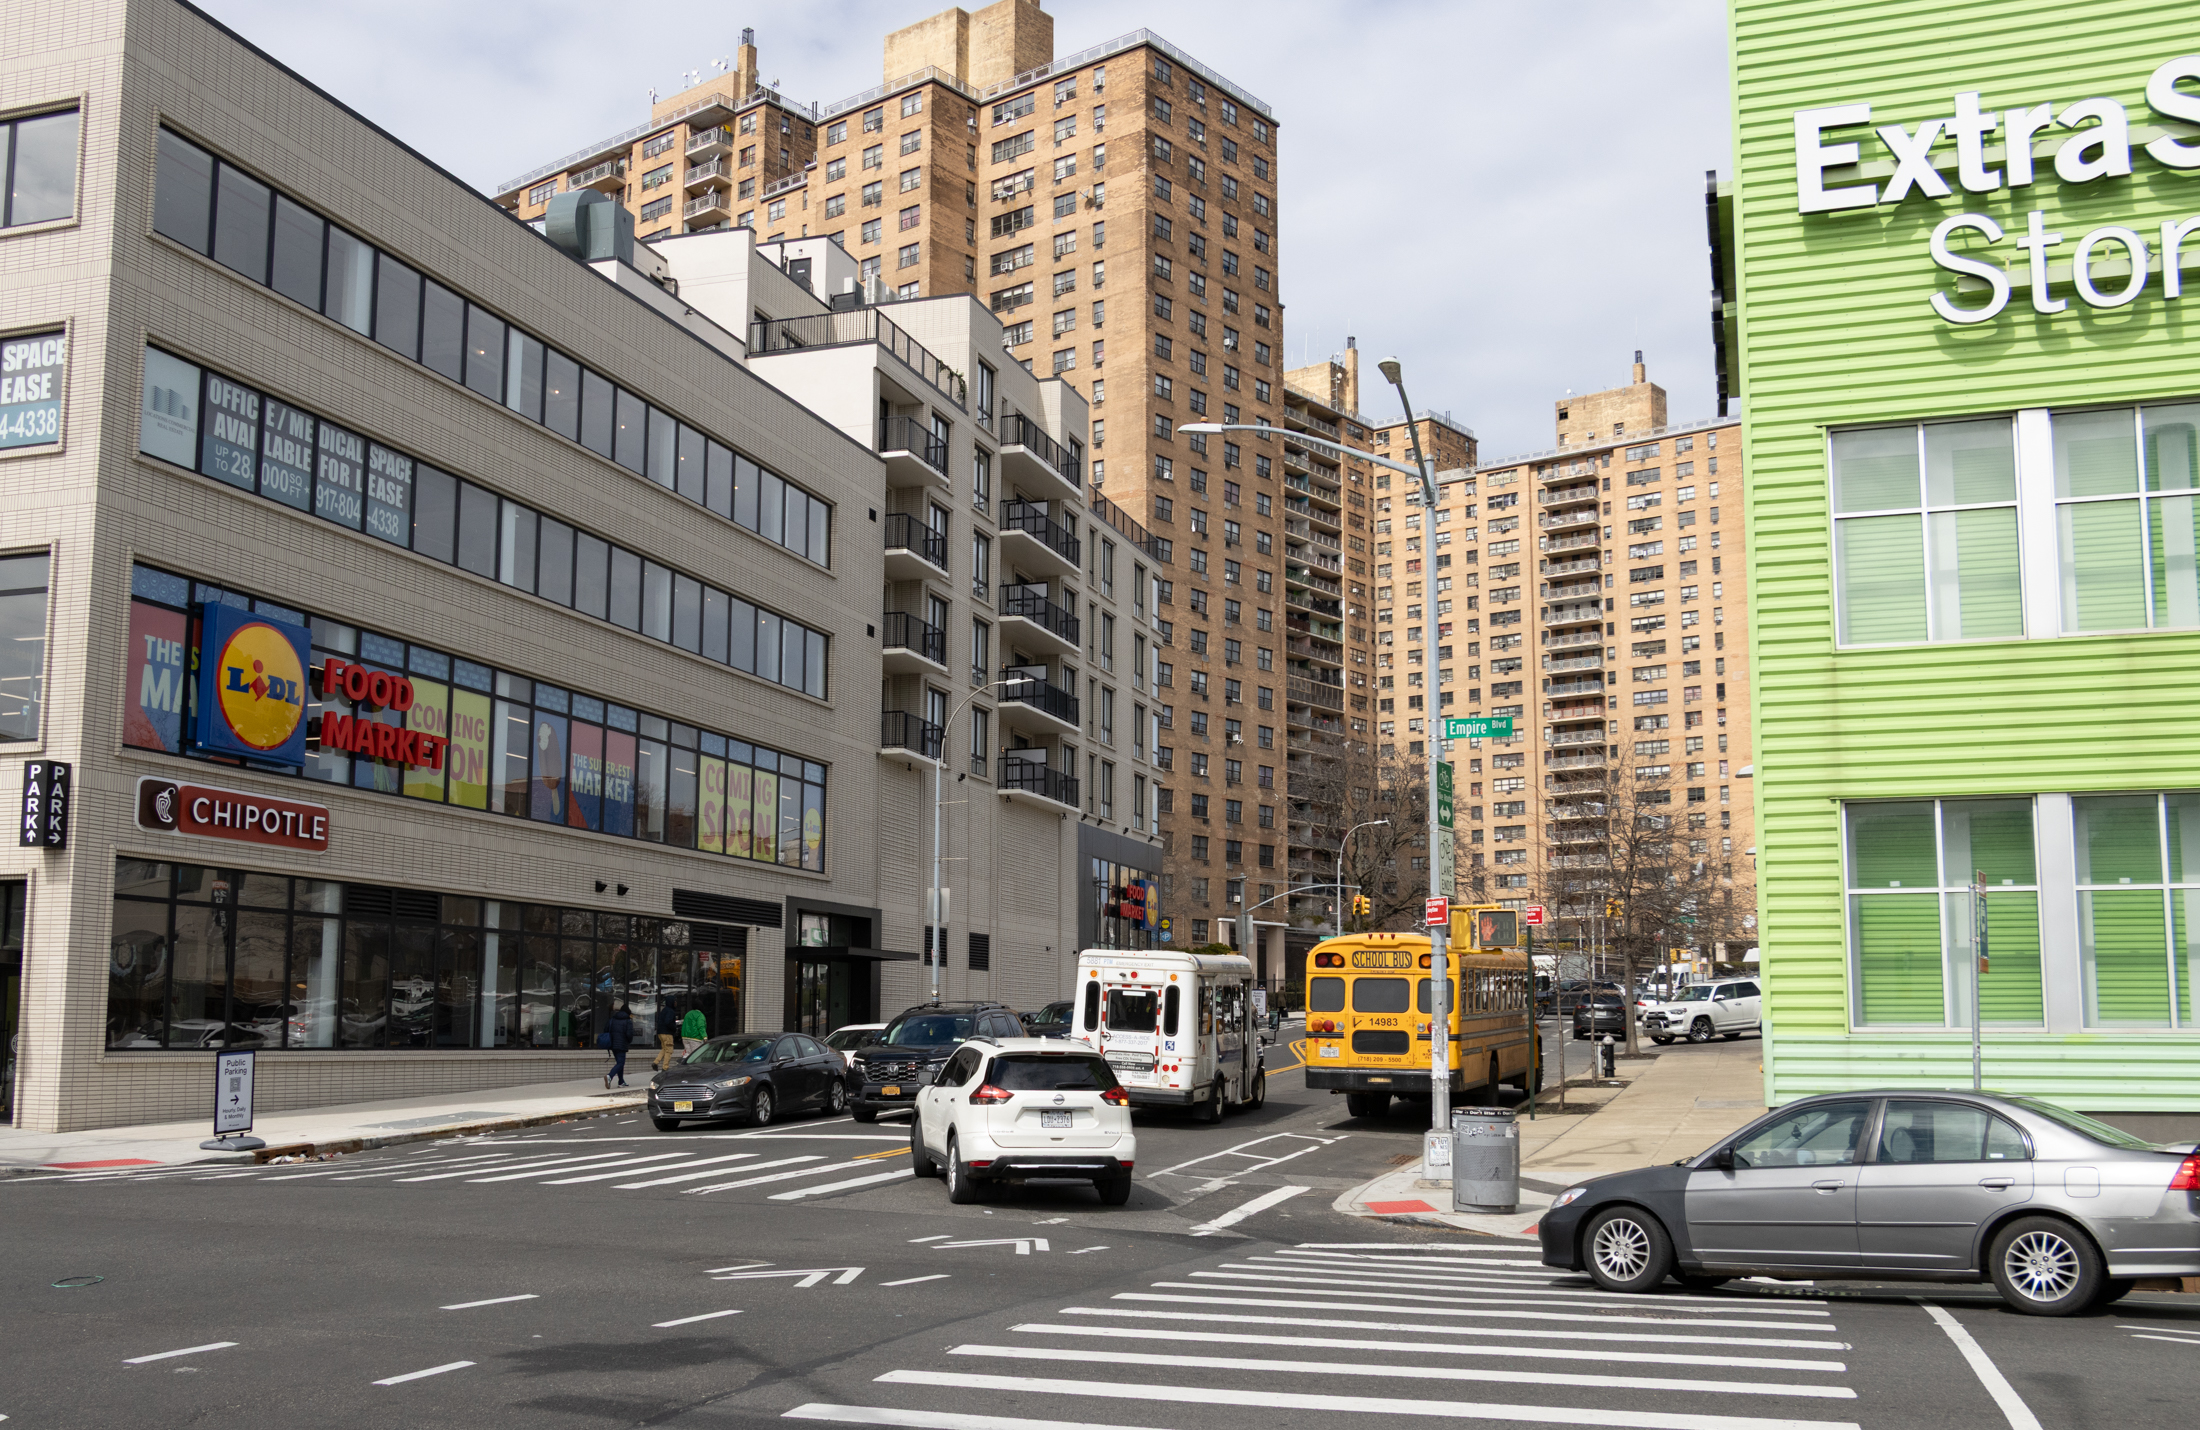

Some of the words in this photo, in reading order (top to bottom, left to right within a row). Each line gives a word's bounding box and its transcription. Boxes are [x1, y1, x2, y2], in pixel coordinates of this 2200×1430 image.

[3, 338, 65, 372] SPACE
[144, 409, 168, 423] LOCATIONS
[157, 422, 168, 430] REAL
[209, 378, 276, 428] OFFICE
[289, 411, 364, 464] MEDICAL
[369, 445, 412, 484] SPACE
[213, 411, 312, 472] AVAILABLE
[319, 453, 350, 488] FOR
[355, 468, 404, 509] LEASE
[215, 457, 229, 471] TO
[289, 486, 301, 498] FT
[215, 444, 229, 457] UP
[230, 450, 289, 493] 28,000
[289, 473, 303, 487] SQ
[316, 484, 399, 537] 917-804-4338
[144, 634, 182, 666] THE
[323, 658, 414, 712] FOOD
[411, 702, 485, 743] COMING
[1450, 721, 1487, 736] Empire
[1491, 719, 1507, 729] Blvd
[321, 710, 449, 770] MARKET
[572, 752, 588, 769] THE
[25, 764, 42, 830] PARK
[49, 767, 66, 832] PARK
[571, 768, 630, 803] MARKET
[705, 763, 772, 807] COMING
[192, 796, 326, 841] CHIPOTLE
[703, 800, 771, 856] SOON
[1440, 863, 1453, 877] LANE
[1441, 880, 1453, 892] ENDS
[1128, 884, 1145, 901] FOOD
[1120, 902, 1145, 920] MARKET
[1354, 952, 1389, 967] SCHOOL
[1393, 952, 1410, 967] BUS
[1369, 1018, 1398, 1026] 14983
[224, 1067, 247, 1076] Parking
[226, 1059, 246, 1067] Public
